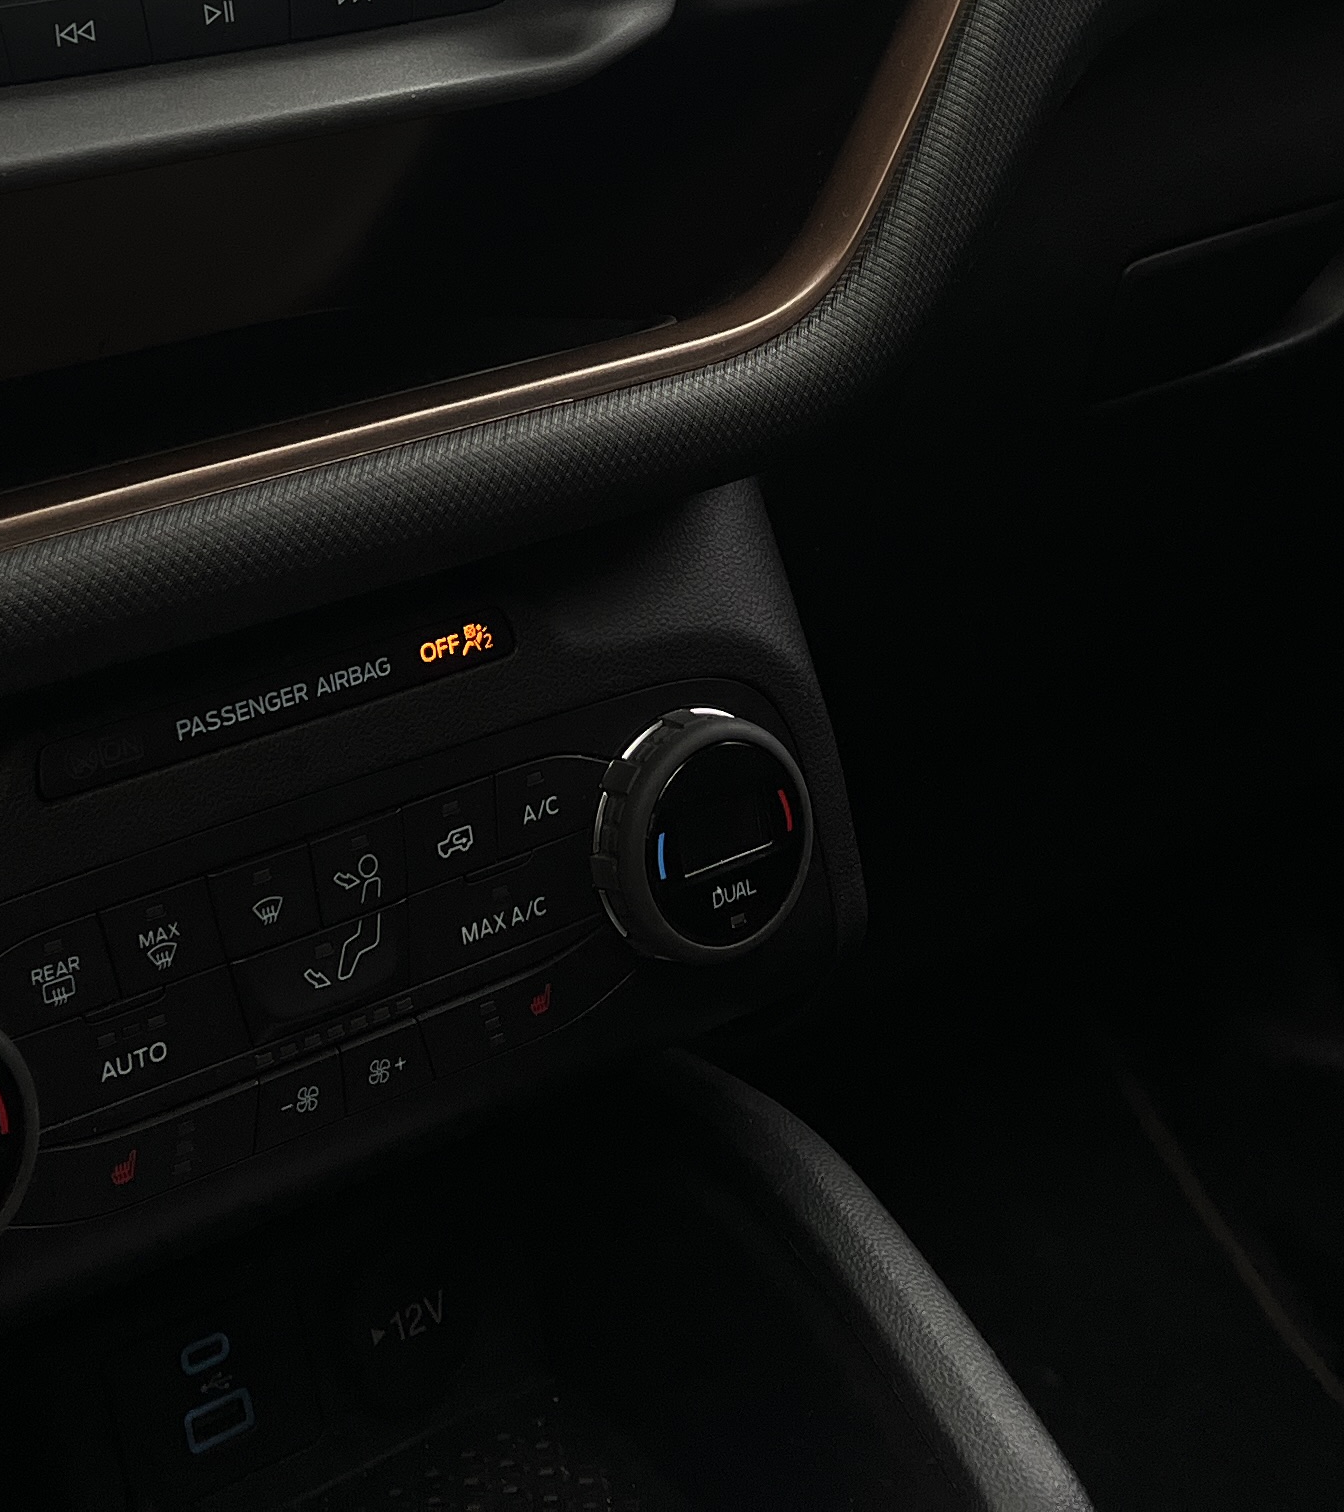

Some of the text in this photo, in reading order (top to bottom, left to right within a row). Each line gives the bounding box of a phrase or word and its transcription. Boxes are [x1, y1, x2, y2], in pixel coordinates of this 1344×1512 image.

[175, 682, 309, 742] PASSENGER
[316, 656, 392, 698] AIRBAG
[419, 633, 461, 663] OFF
[522, 795, 560, 825] A/C
[712, 878, 758, 910] DUAL
[138, 921, 181, 949] MAX
[460, 895, 548, 946] MAX A/C
[30, 955, 81, 986] REAR
[100, 1040, 168, 1083] AUTO
[388, 1288, 444, 1341] 12V
